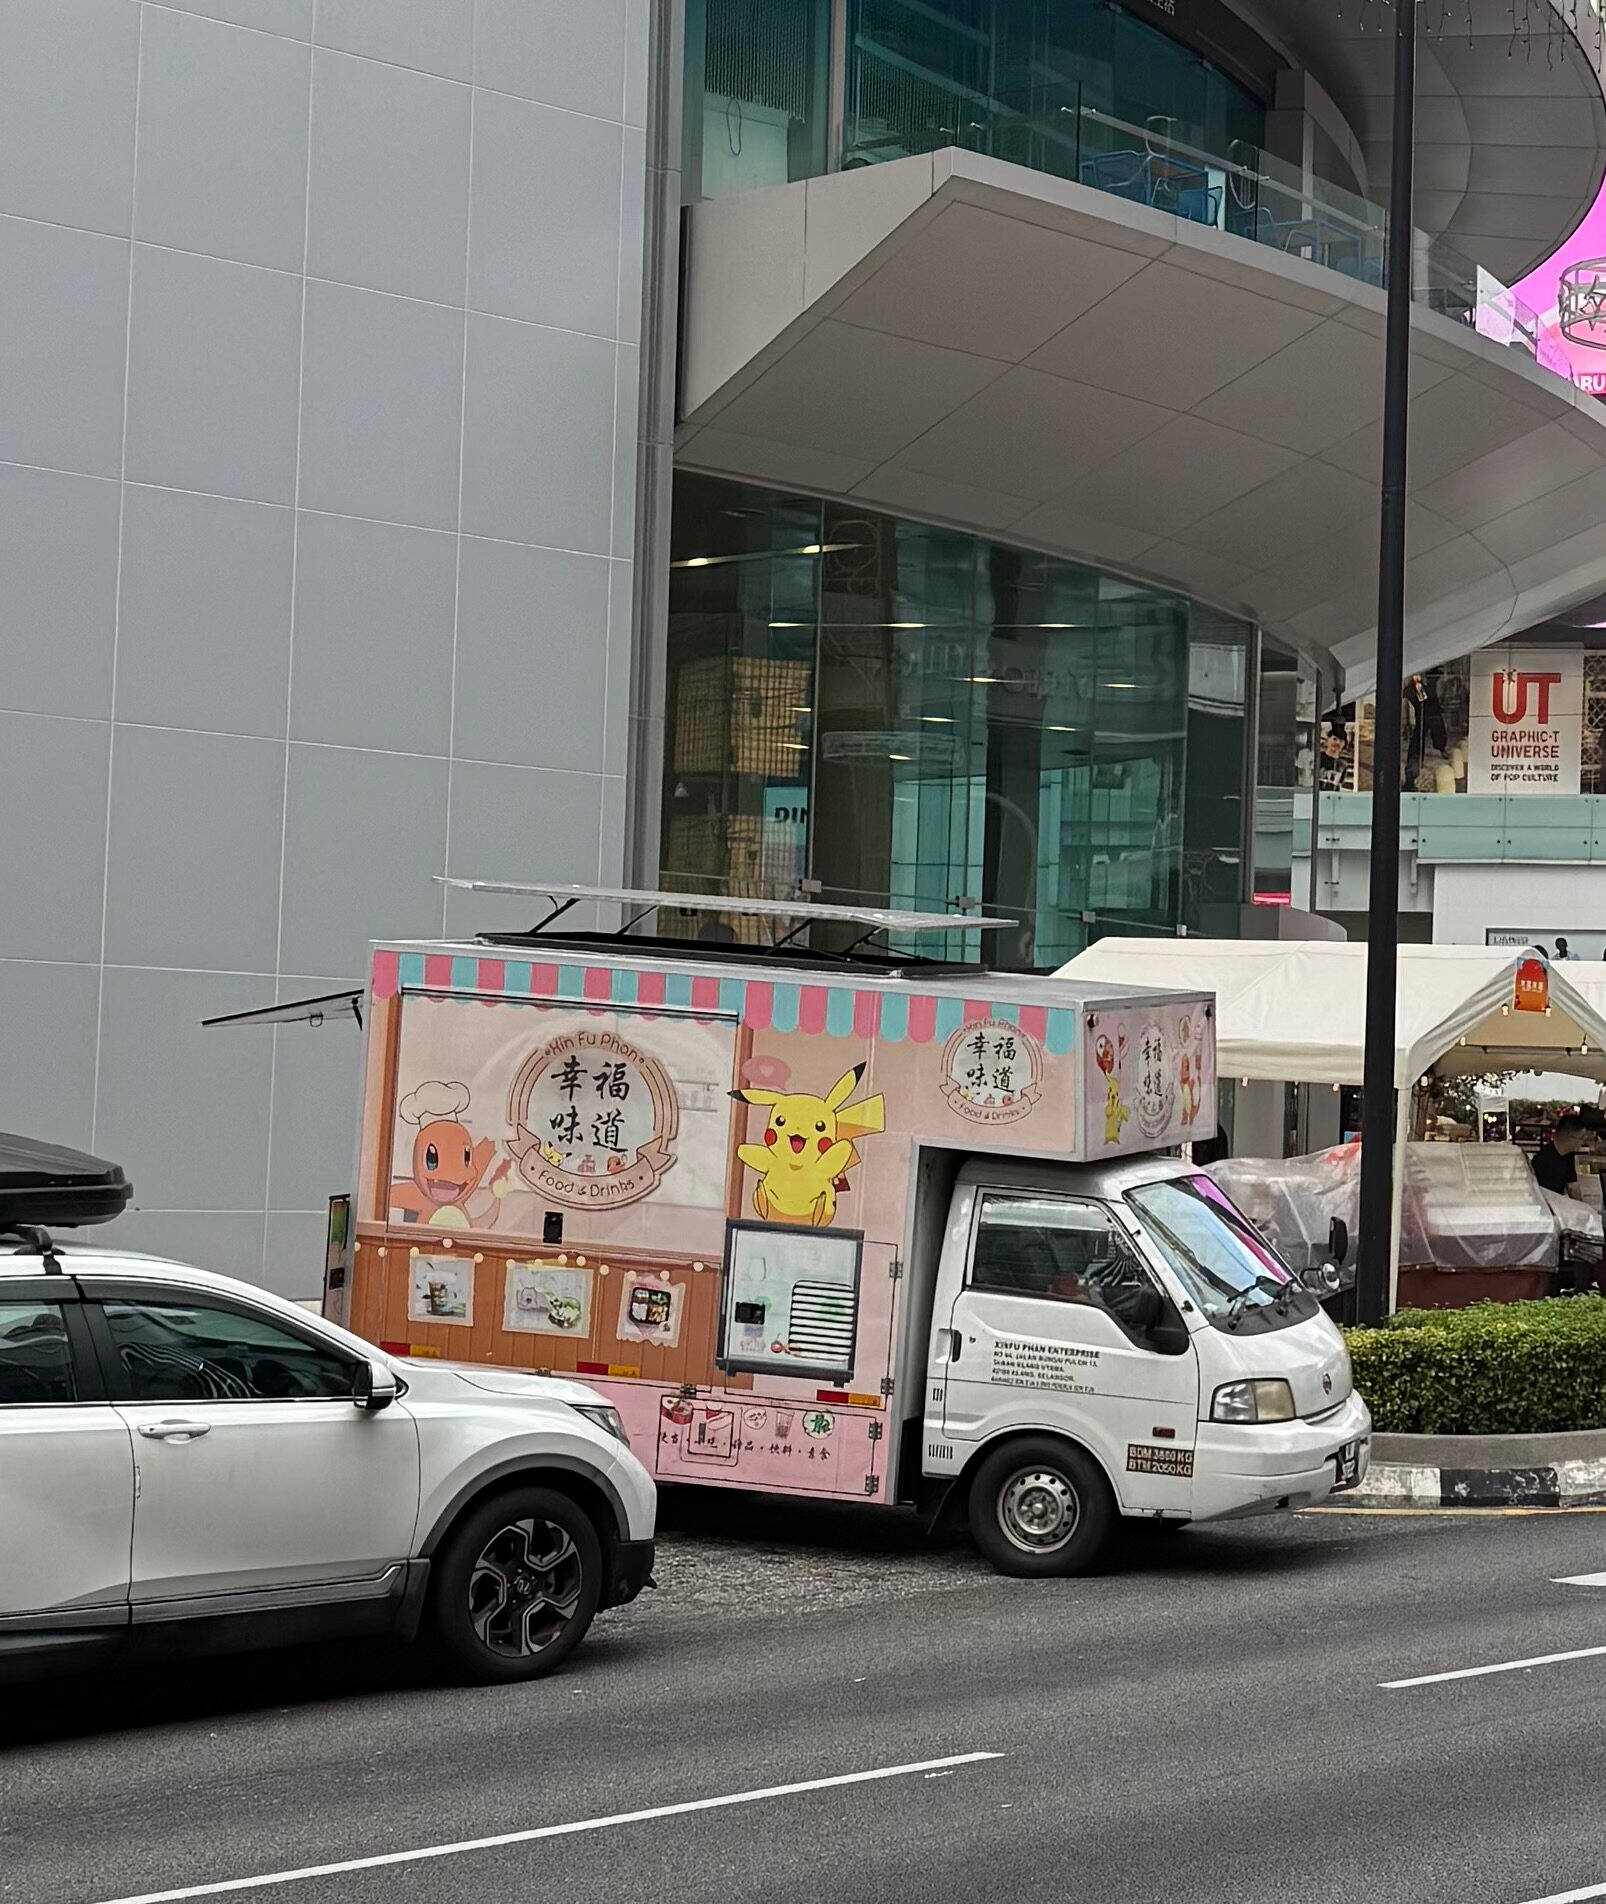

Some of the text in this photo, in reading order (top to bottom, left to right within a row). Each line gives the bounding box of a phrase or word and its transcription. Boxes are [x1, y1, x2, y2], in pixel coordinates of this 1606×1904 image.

[1492, 672, 1562, 726] UT
[1491, 730, 1560, 744] GRAPHIC-T
[1491, 745, 1560, 759] UNIVERSE
[578, 1032, 597, 1047] Fu
[600, 1033, 638, 1062] Phan
[966, 1031, 1017, 1061] 幸福
[550, 1054, 631, 1102] 幸福
[966, 1063, 1017, 1094] 味道
[549, 1105, 629, 1153] 味道
[538, 1169, 575, 1196] Food
[589, 1179, 636, 1198] Drinks
[1047, 1346, 1101, 1359] ENTERPRISE
[1128, 1458, 1152, 1471] BTM
